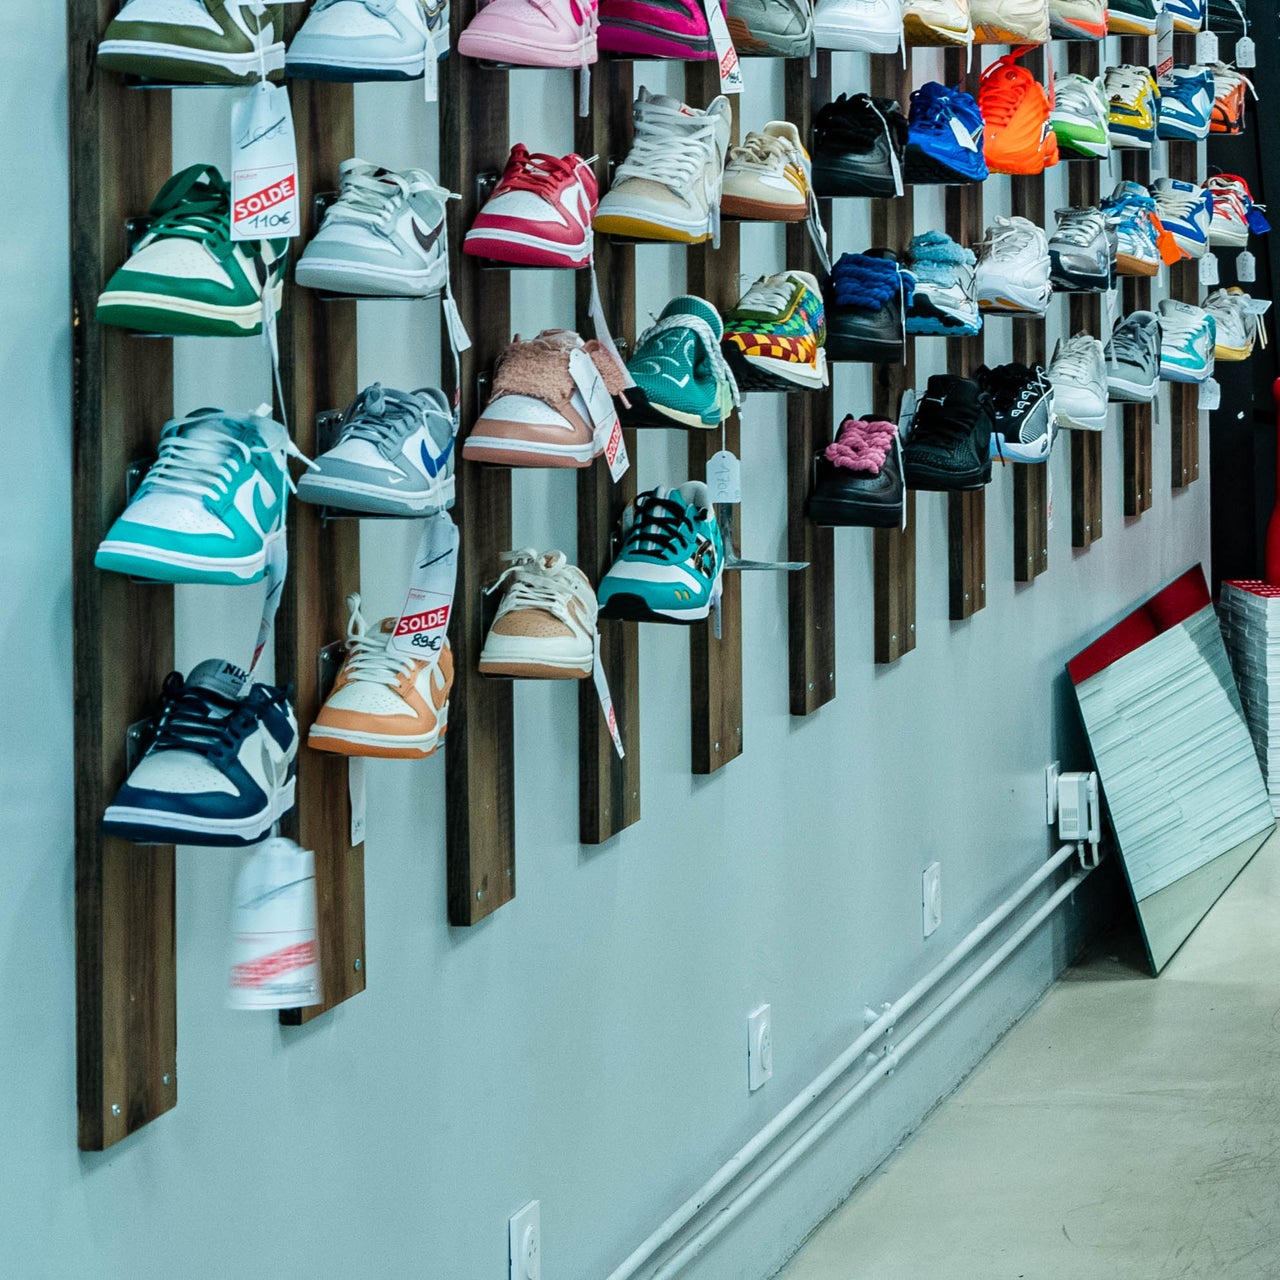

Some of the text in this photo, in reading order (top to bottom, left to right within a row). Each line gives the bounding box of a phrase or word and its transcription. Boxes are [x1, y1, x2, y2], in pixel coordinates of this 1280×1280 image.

[235, 180, 294, 219] SOLDÉ
[249, 211, 292, 229] 110€
[399, 609, 446, 634] SOLDÉ
[411, 633, 441, 651] 89€
[222, 662, 250, 683] NIK
